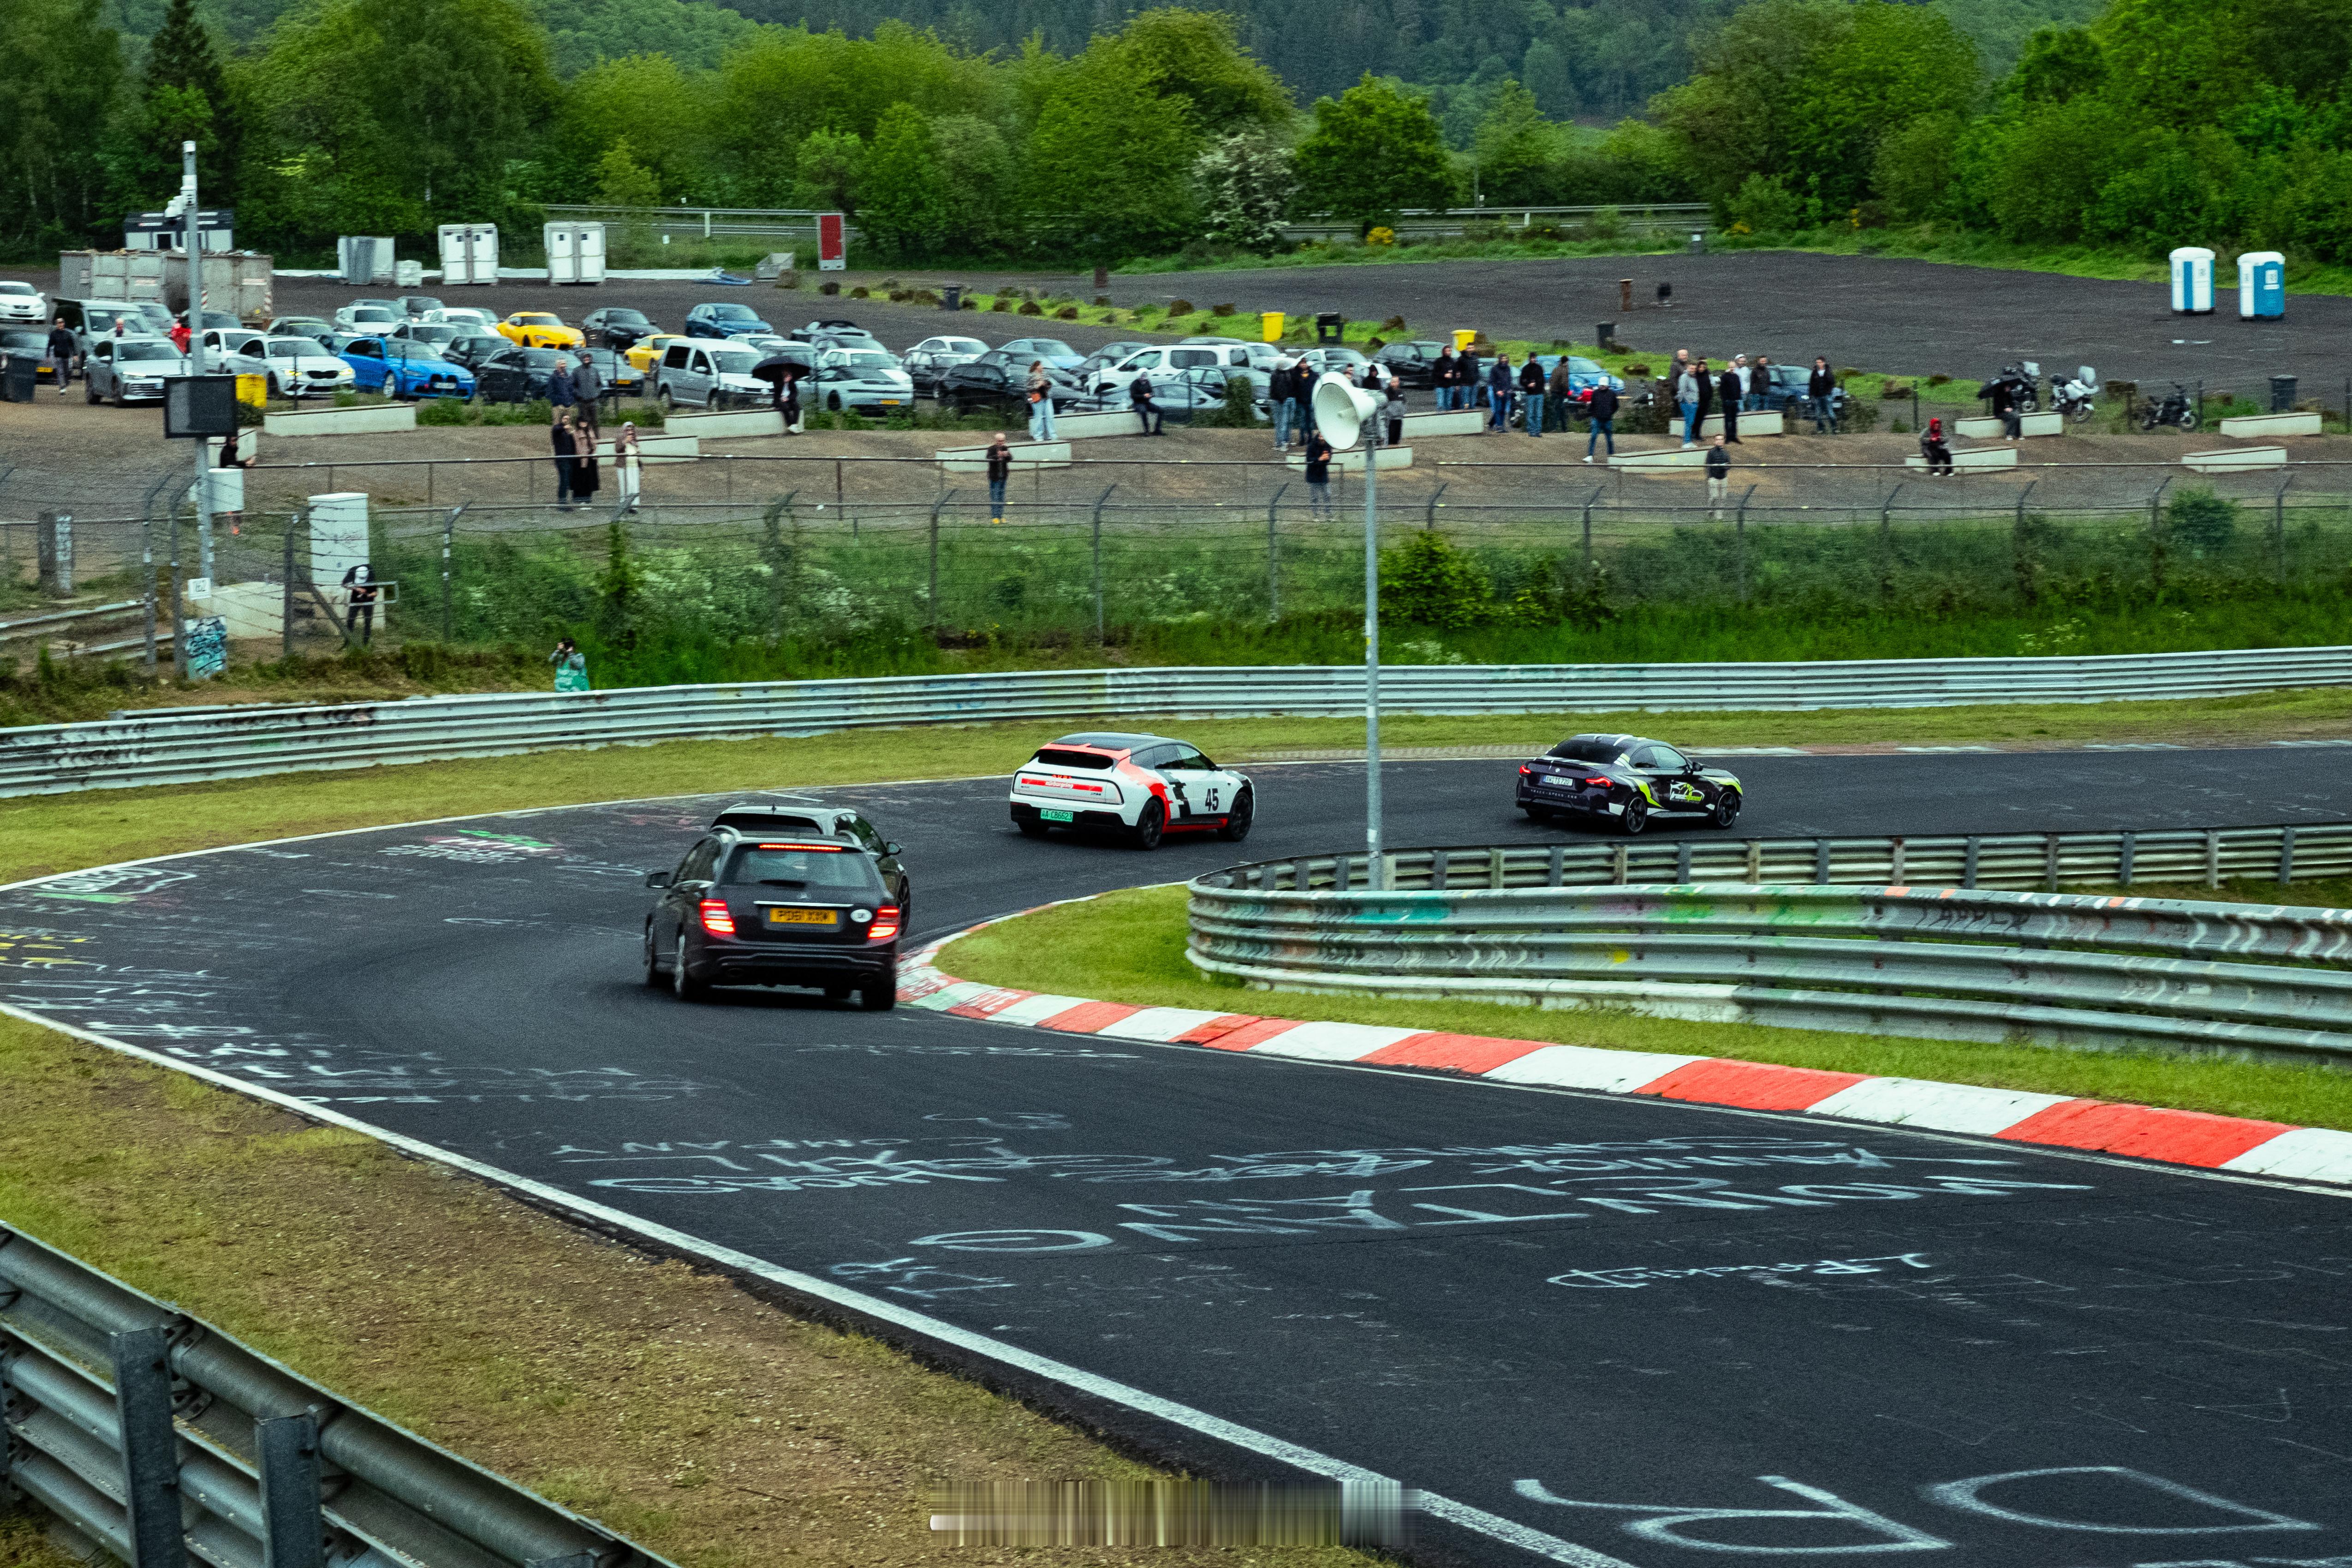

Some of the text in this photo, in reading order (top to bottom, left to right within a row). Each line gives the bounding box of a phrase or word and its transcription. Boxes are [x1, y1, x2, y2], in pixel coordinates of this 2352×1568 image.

[1205, 788, 1219, 811] 45
[550, 1136, 1002, 1156] COMPANY
[1471, 1147, 2023, 1174] YANNICK
[587, 1169, 1007, 1193] LUCAS
